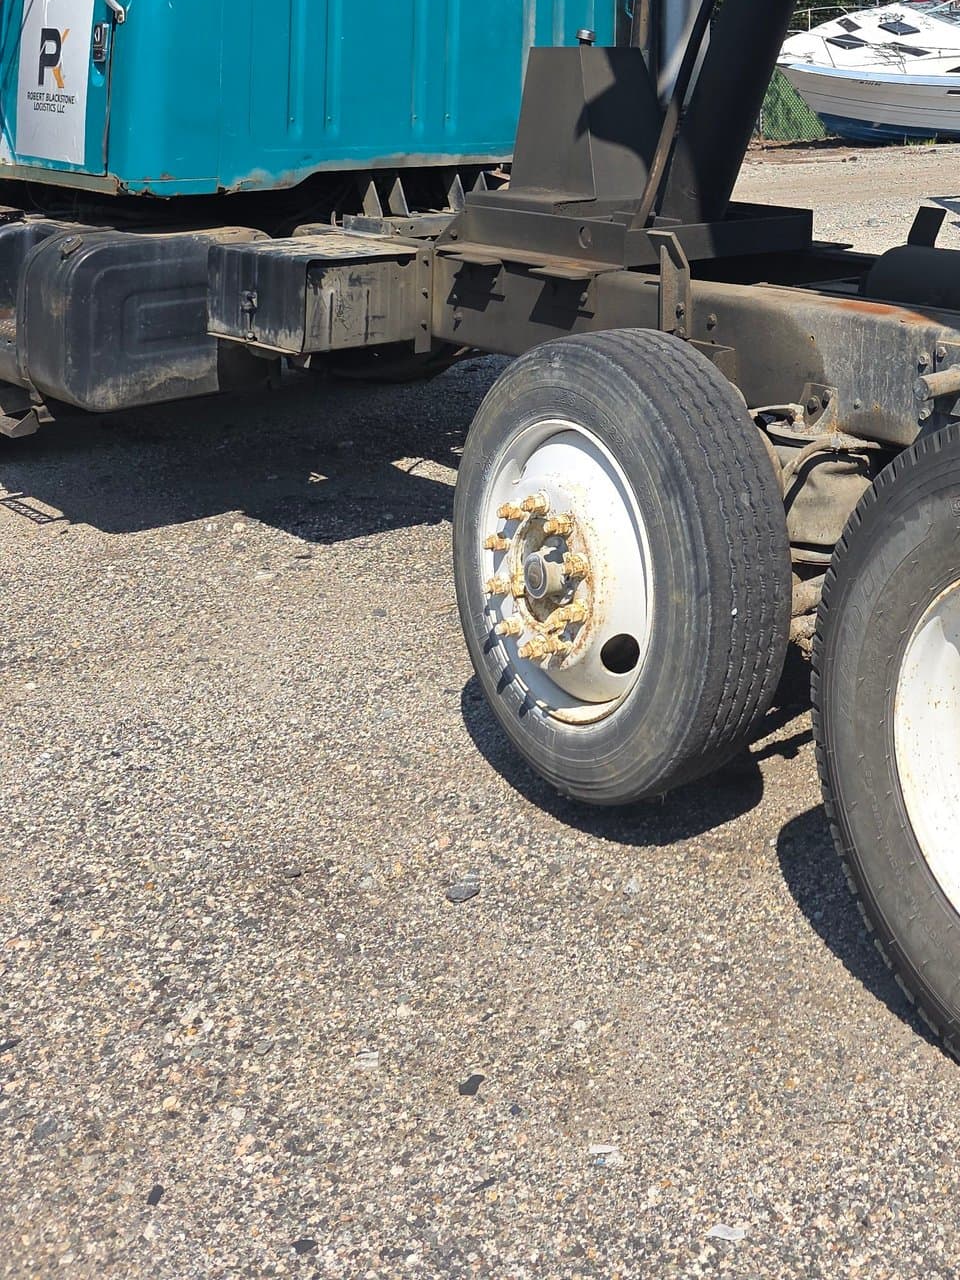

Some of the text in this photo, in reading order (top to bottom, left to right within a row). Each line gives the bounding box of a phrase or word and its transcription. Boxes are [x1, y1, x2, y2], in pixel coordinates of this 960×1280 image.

[27, 91, 75, 104] ROBERT BLACKSTONE
[33, 102, 65, 114] LOGISTICS LLC
